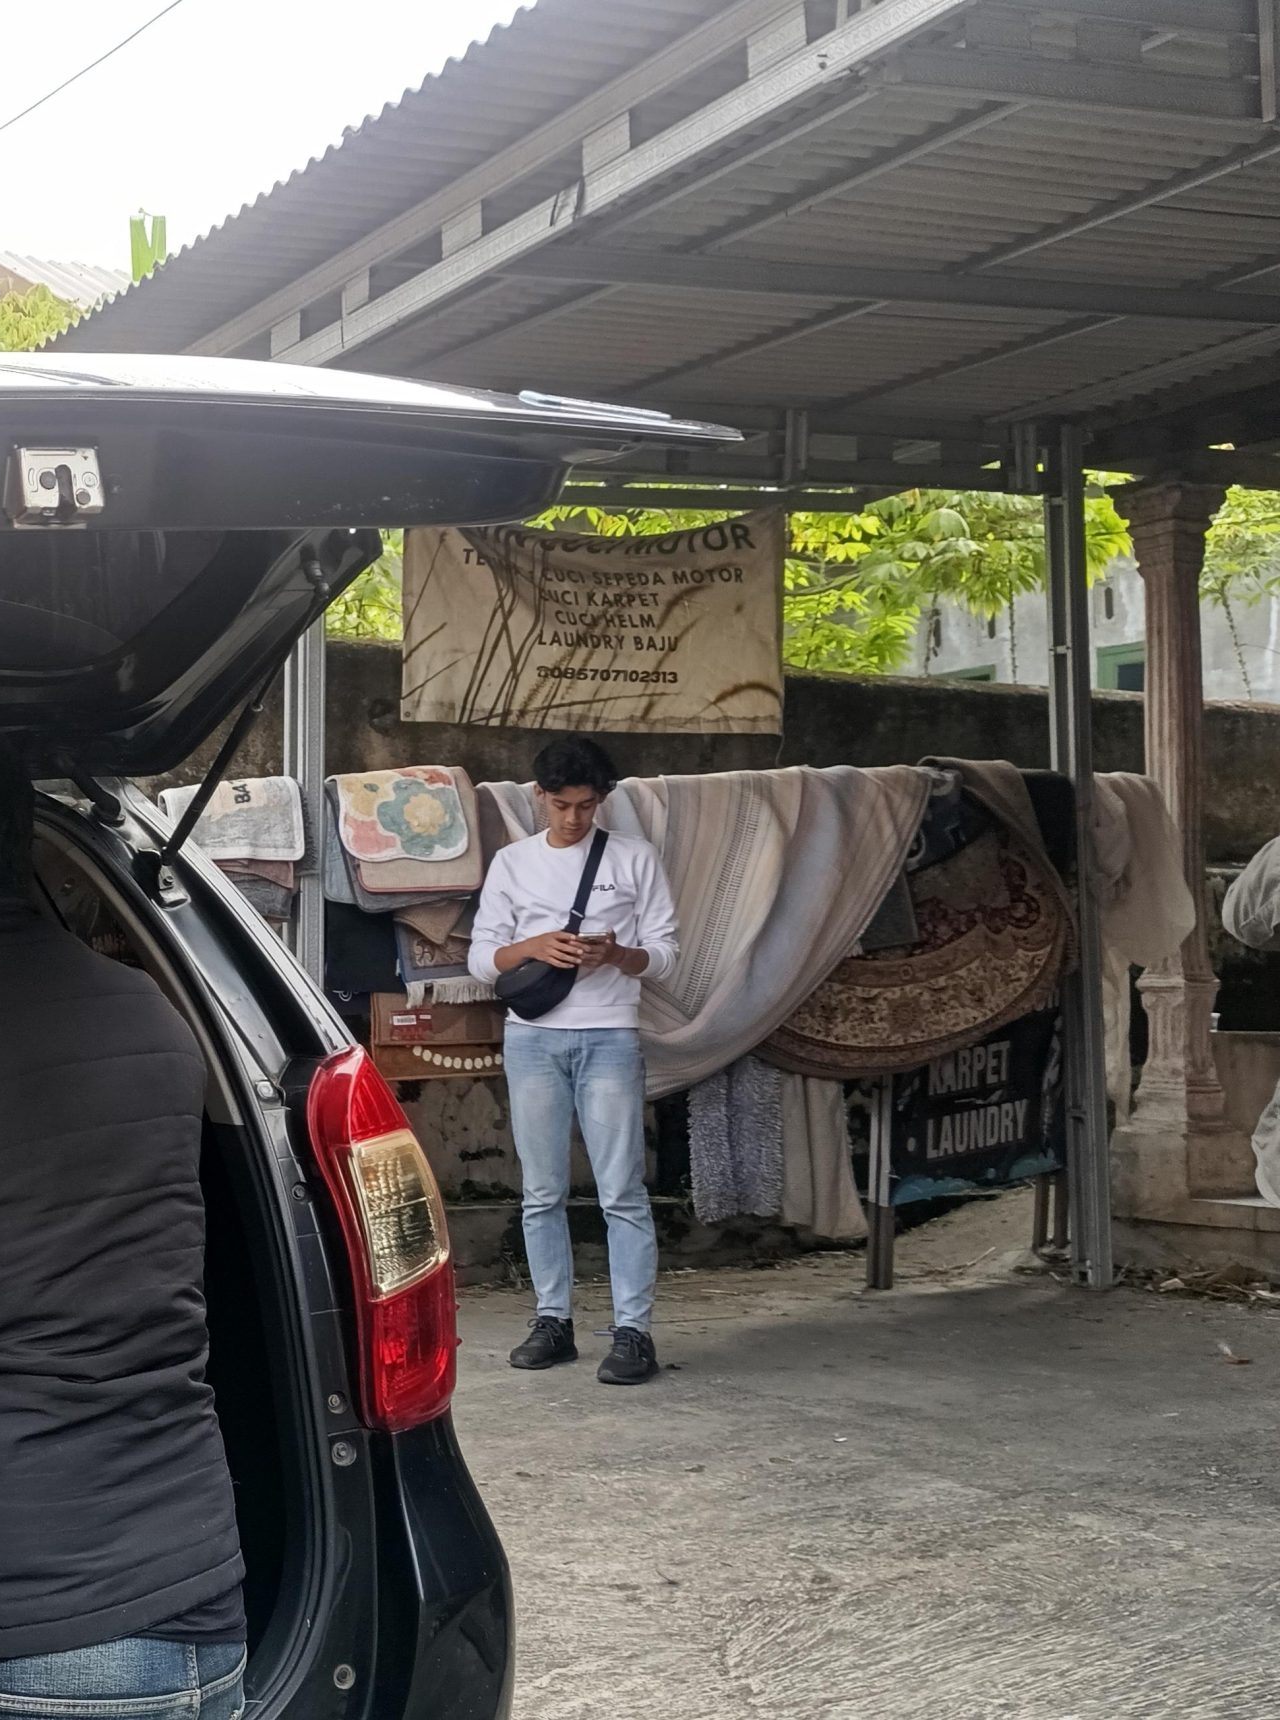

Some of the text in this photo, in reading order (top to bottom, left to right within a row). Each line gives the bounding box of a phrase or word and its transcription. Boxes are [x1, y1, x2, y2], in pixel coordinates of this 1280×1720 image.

[592, 571, 666, 586] SEPEDA
[672, 567, 744, 585] MOTOR
[586, 591, 660, 608] KARPET
[555, 609, 656, 628] CUCI HELM
[537, 629, 679, 652] LAUNDRY BAJU
[928, 1040, 1011, 1096] KARPET
[926, 1098, 1029, 1160] LAUNDRY
